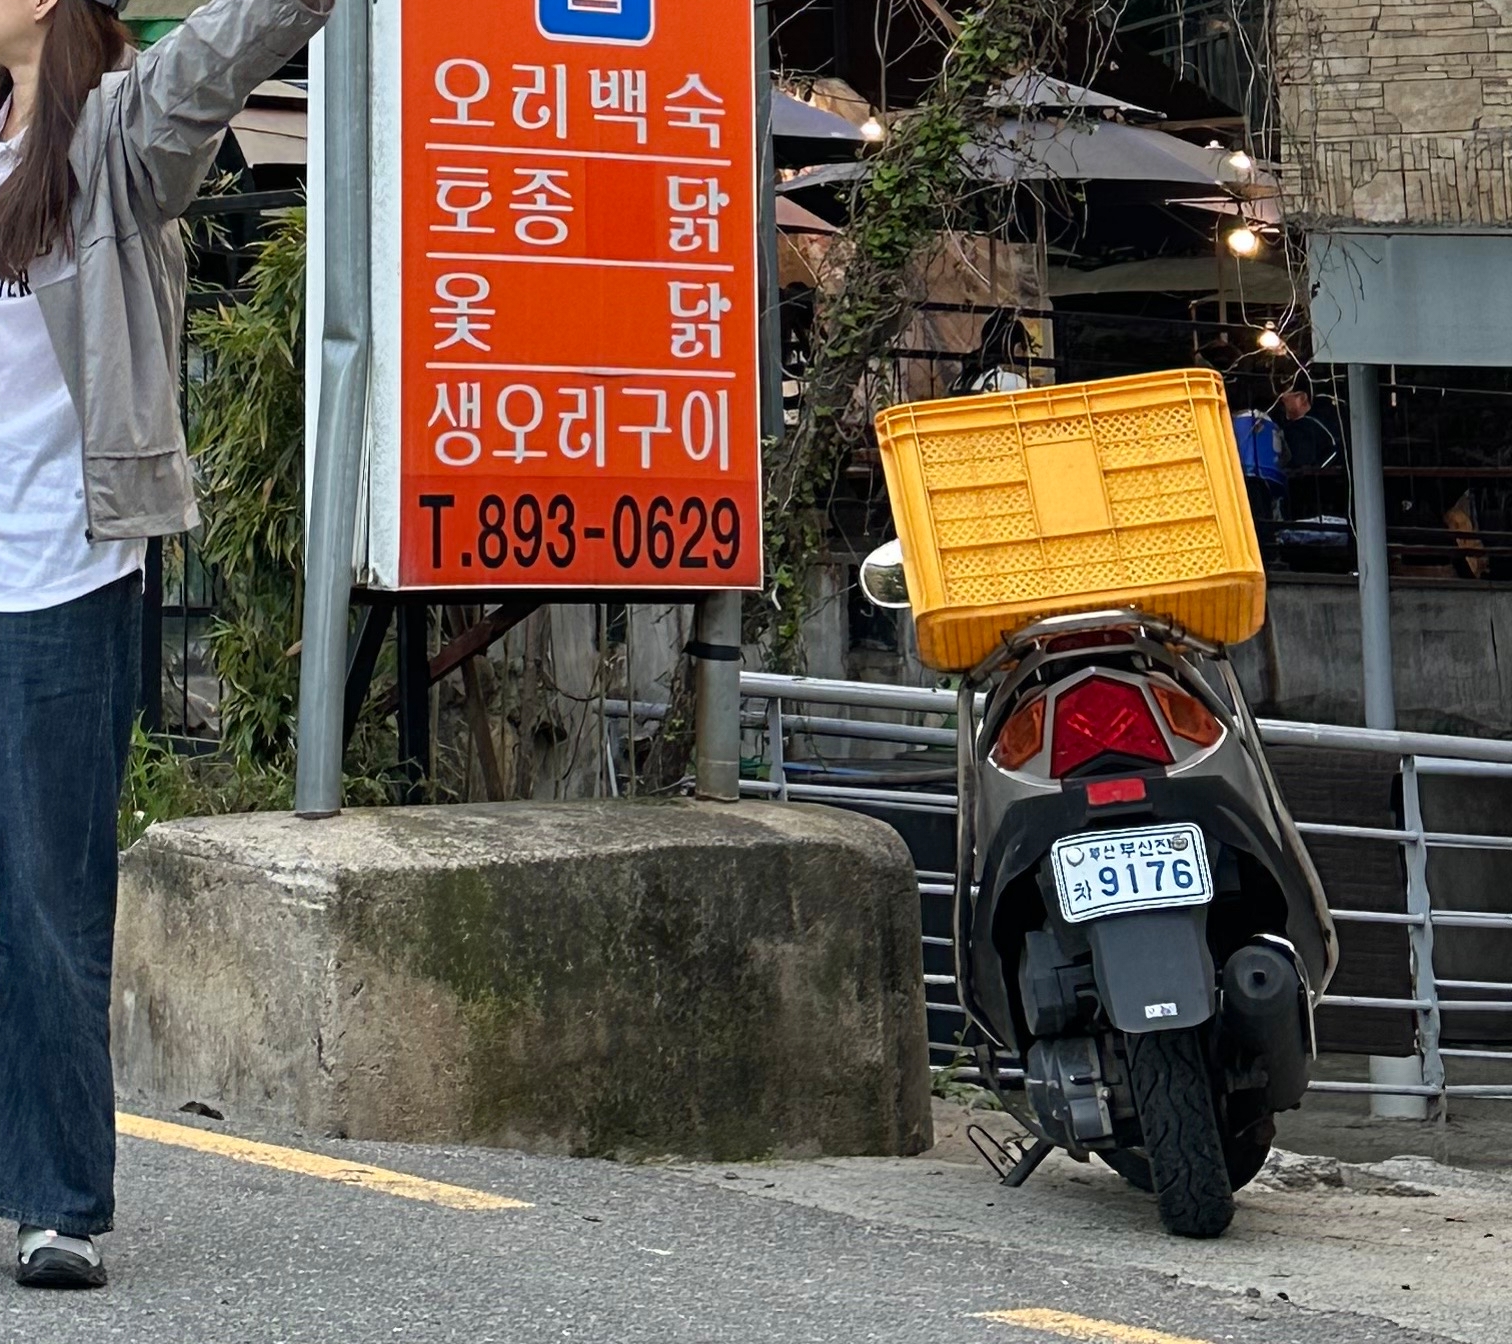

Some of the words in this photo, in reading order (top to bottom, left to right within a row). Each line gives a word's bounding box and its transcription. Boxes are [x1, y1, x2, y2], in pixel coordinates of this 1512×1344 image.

[429, 58, 726, 149] 오리백숙
[429, 166, 574, 246] 토종
[666, 175, 730, 253] 닭
[429, 272, 496, 352] 옻
[666, 281, 732, 360] 닭
[427, 381, 730, 472] 생오리구이
[419, 493, 742, 570] T.893-0629
[1098, 859, 1194, 897] 9176
